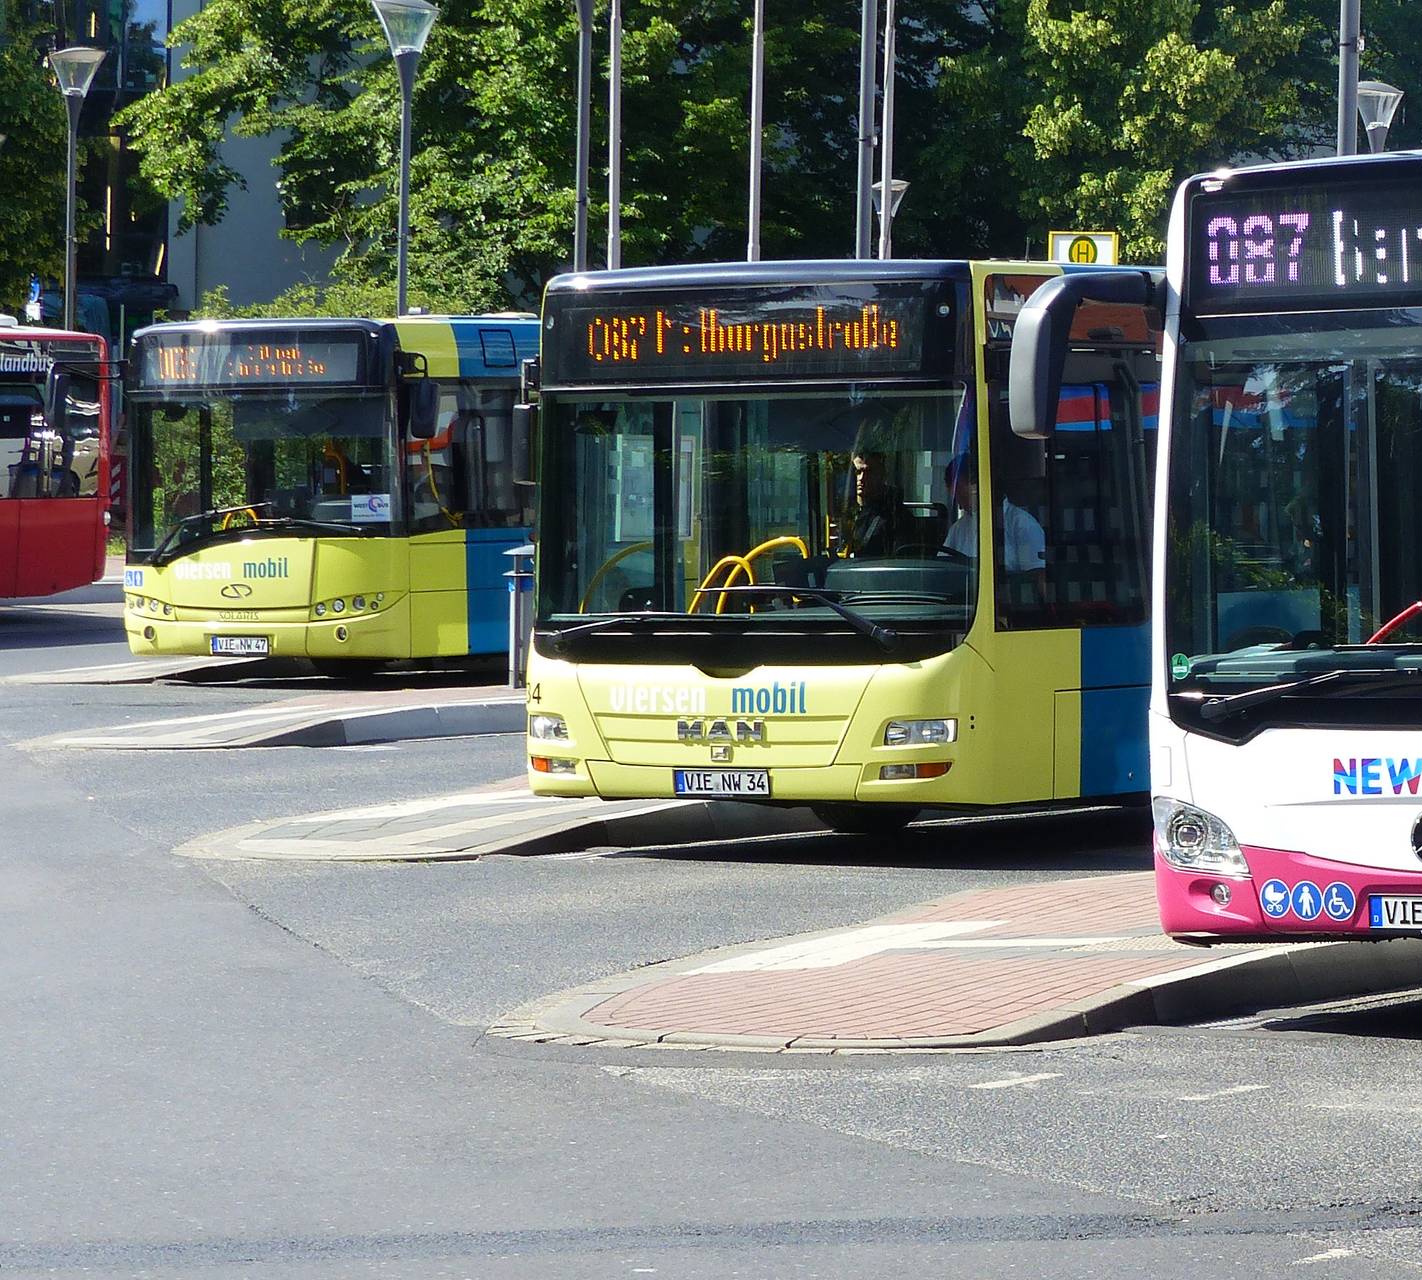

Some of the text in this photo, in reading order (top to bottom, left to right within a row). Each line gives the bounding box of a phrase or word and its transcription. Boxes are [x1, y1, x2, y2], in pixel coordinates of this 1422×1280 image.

[1077, 243, 1089, 263] H
[1207, 213, 1309, 284] 087
[243, 557, 288, 578] mobil
[218, 639, 266, 650] VIE NW 47
[610, 681, 806, 713] viersen mobil
[677, 720, 765, 741] MAN
[685, 773, 714, 791] VIE
[721, 773, 741, 791] NW
[747, 773, 766, 791] 34
